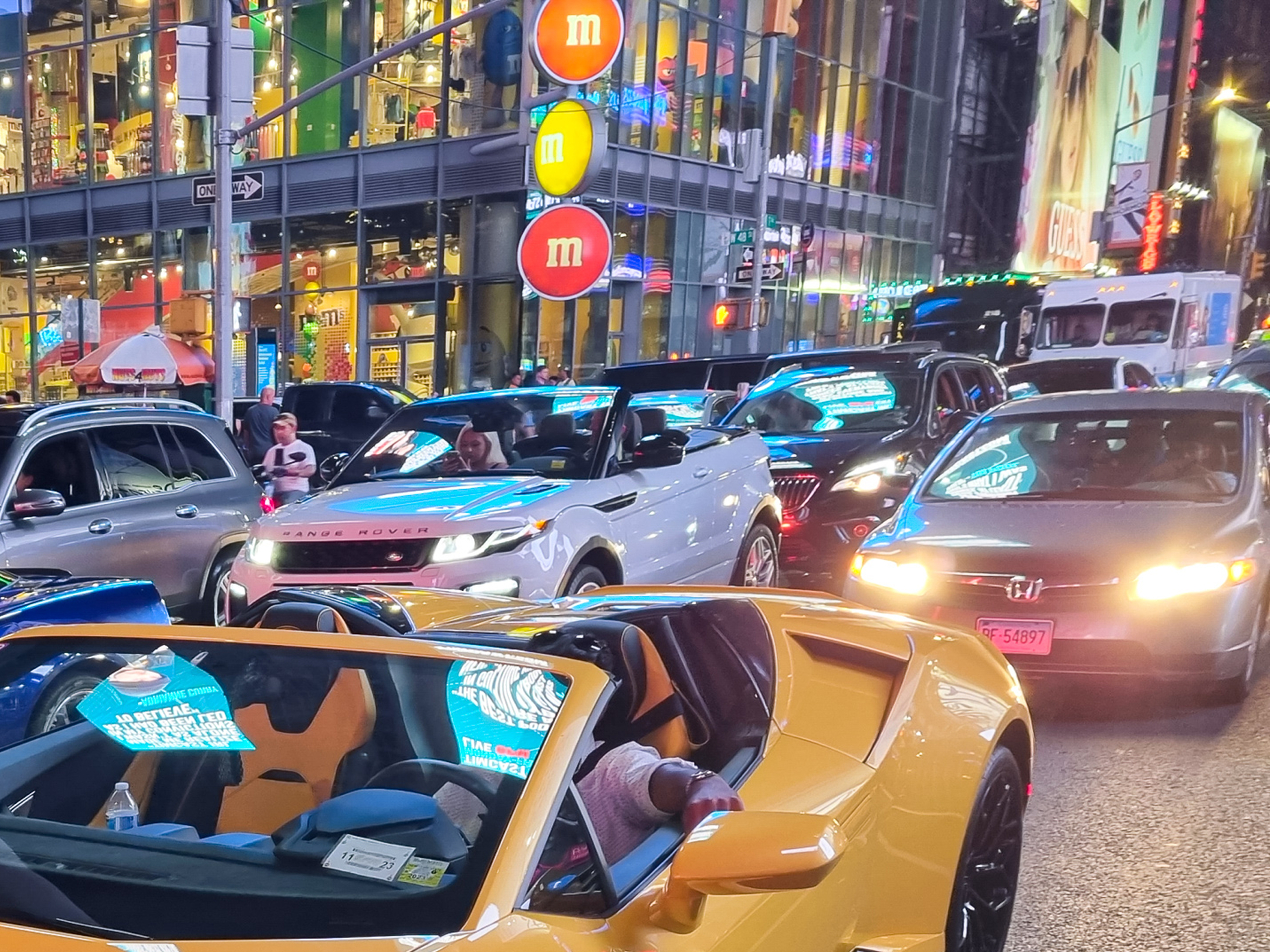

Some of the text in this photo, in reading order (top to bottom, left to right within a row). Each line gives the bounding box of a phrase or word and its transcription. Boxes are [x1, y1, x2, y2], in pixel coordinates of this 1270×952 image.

[566, 14, 601, 46] m
[541, 132, 564, 165] m
[232, 181, 253, 193] WAY
[546, 237, 583, 268] m
[359, 527, 429, 536] ROVER
[341, 852, 395, 870] 11 23
